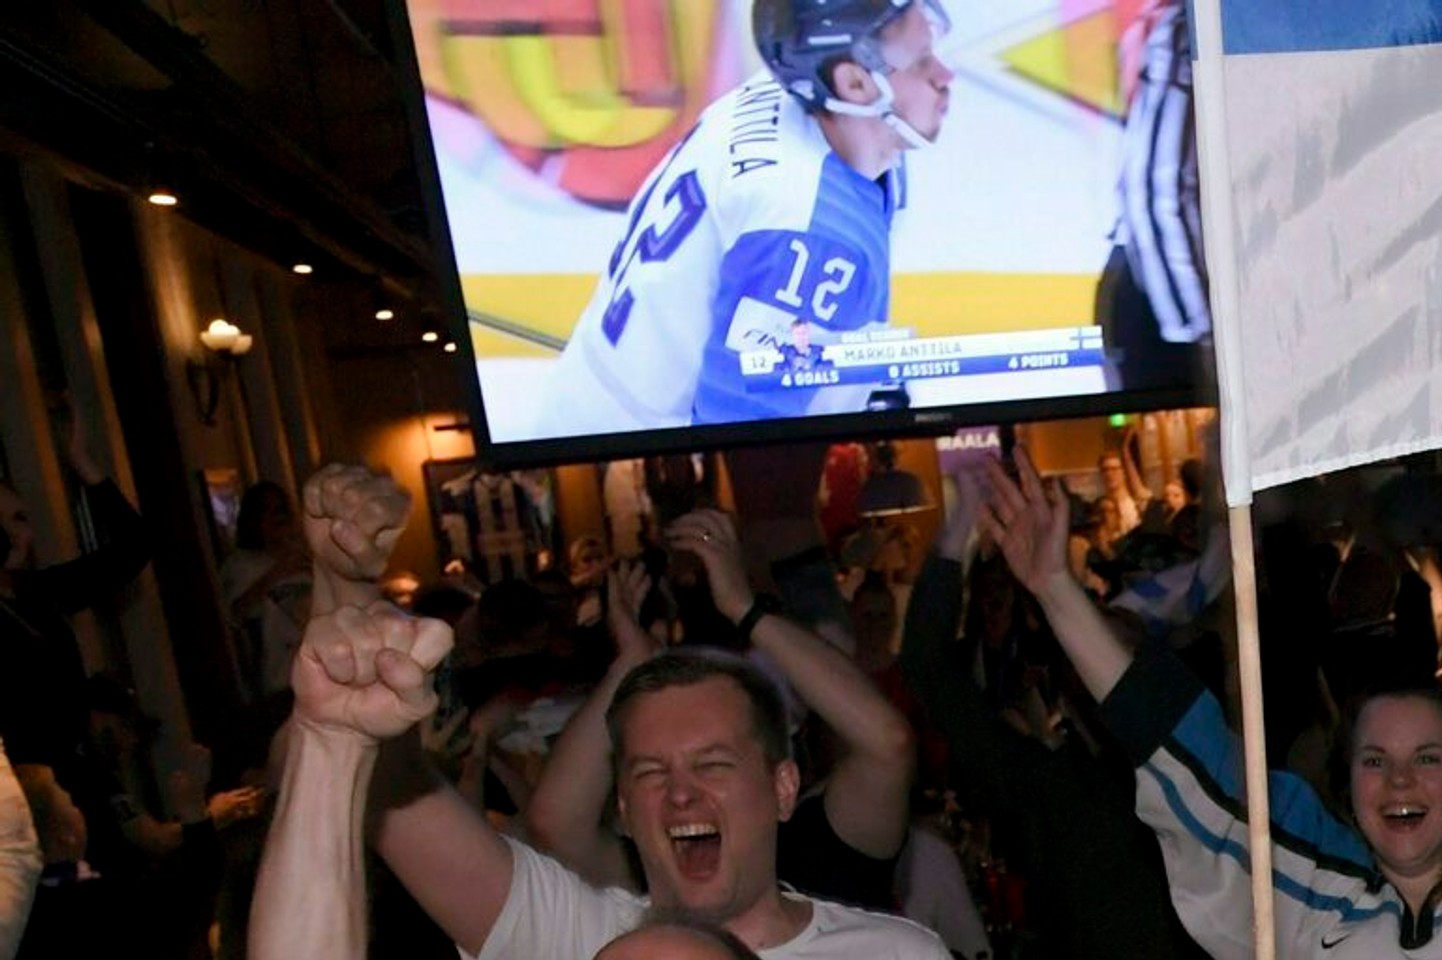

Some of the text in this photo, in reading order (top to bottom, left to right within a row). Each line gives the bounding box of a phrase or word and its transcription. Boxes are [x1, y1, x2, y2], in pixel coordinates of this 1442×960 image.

[775, 239, 857, 322] 12
[844, 343, 963, 361] MARKO ANTTILA
[1021, 352, 1069, 367] POINTS
[794, 369, 840, 385] GOALS
[902, 360, 960, 377] ASSISTS
